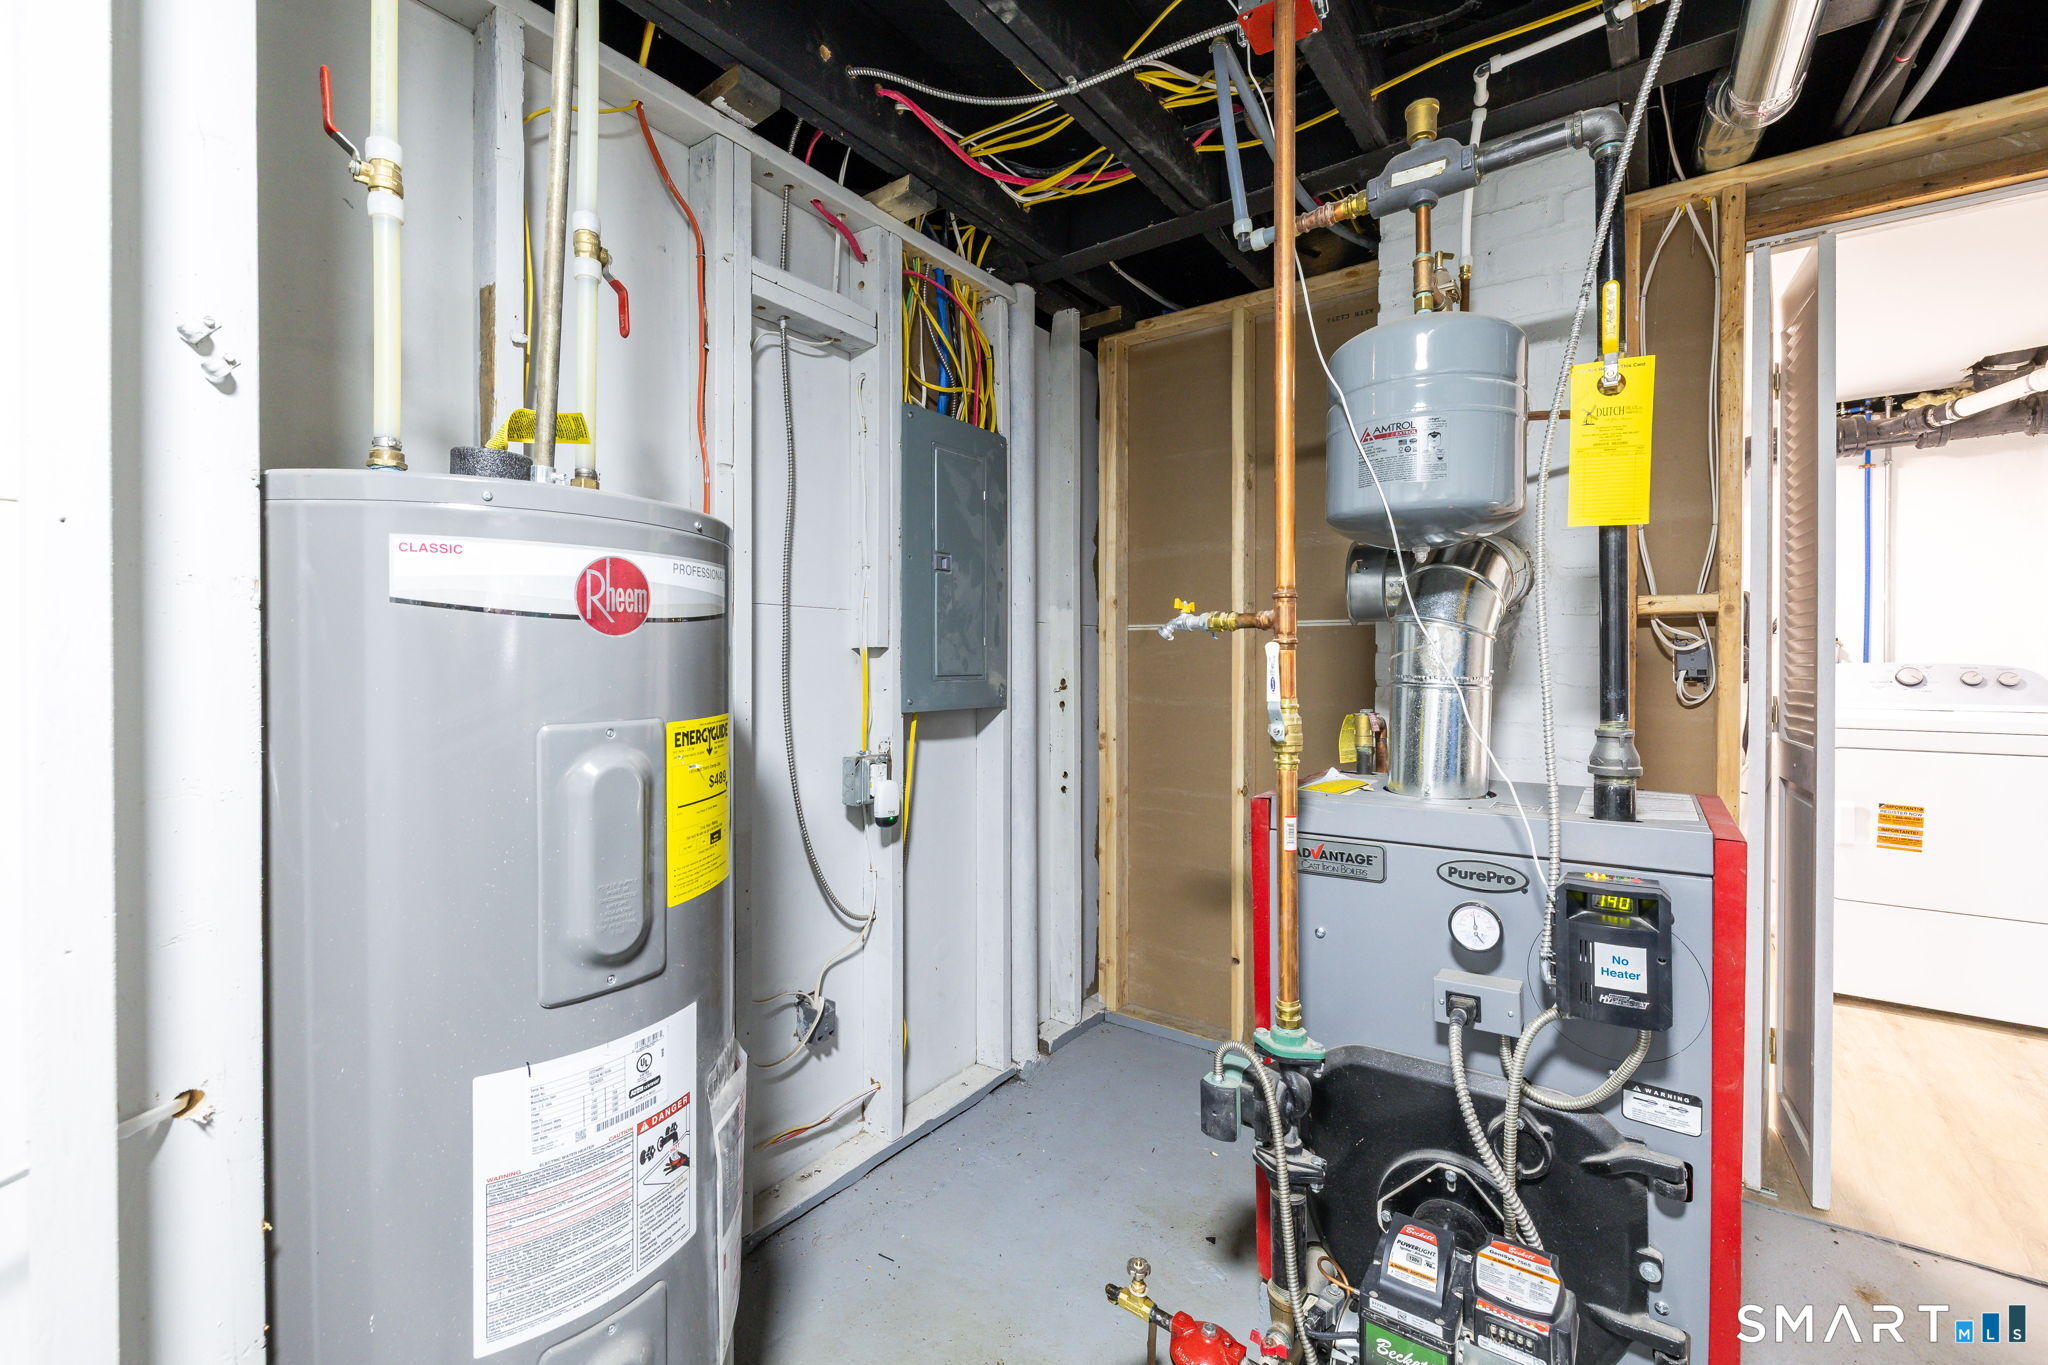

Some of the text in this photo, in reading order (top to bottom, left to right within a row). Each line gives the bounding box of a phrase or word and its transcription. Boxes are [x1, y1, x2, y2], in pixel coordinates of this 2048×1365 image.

[1596, 405, 1625, 417] DUTCH
[1372, 420, 1416, 435] AMTROL
[398, 542, 464, 555] CLASSIC
[586, 558, 648, 624] Rheem
[674, 722, 728, 748] ENERGYGUIDE
[1448, 866, 1516, 886] PurePro
[1612, 955, 1629, 966] No
[1600, 966, 1641, 980] Heater
[1644, 1087, 1690, 1103] WARNING
[651, 1096, 688, 1126] DANGER
[608, 1126, 633, 1141] CAUTION
[486, 1169, 522, 1183] WARNING
[1405, 1226, 1435, 1242] Beckett
[1396, 1239, 1437, 1257] POWERLIGHT
[1508, 1246, 1536, 1260] Beckett
[1375, 1337, 1428, 1365] Becke
